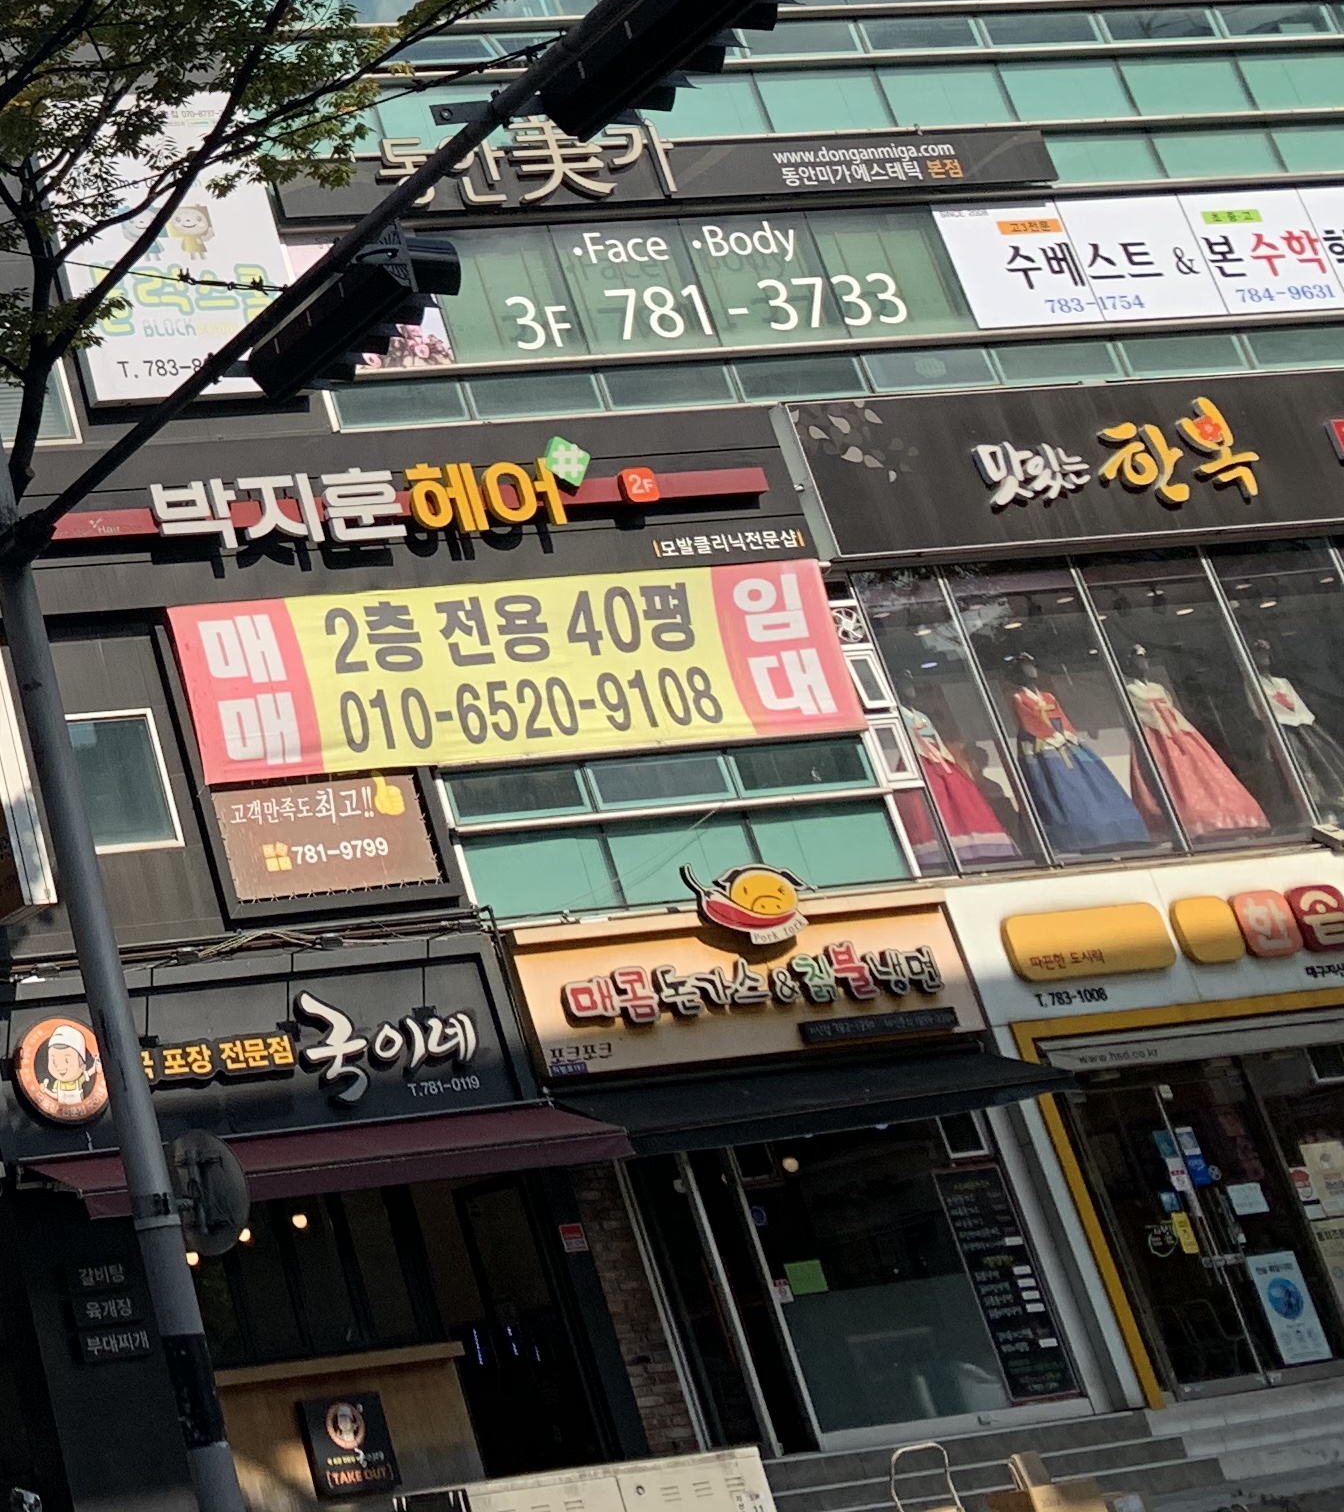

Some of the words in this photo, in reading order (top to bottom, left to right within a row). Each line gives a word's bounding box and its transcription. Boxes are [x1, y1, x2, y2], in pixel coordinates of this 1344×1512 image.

[772, 140, 955, 166] www.donganmiga.com
[781, 161, 924, 187] 동안미가에스테틱
[925, 157, 964, 181] 본점
[1005, 241, 1165, 291] 수베스트
[1173, 246, 1202, 277] &
[1044, 294, 1147, 316] 783-1754
[1235, 284, 1337, 305] 784-9631
[142, 318, 197, 338] BLOCK
[505, 294, 573, 351] 3F
[973, 441, 1091, 507] 맛있는
[1097, 396, 1261, 505] 한복
[628, 473, 655, 495] 2F
[660, 530, 799, 557] 모발클리닉전문샵
[324, 596, 425, 676] 2층
[439, 591, 551, 669] 전용
[566, 581, 695, 656] 40평
[732, 572, 839, 716] 임대
[339, 664, 724, 754] 010-6520-9108
[229, 797, 313, 826] 고객만족도
[315, 785, 375, 824] 최고!!
[291, 836, 389, 865] 781-9799
[1029, 952, 1067, 969] 따끈한
[1070, 948, 1106, 966] 도시락
[163, 1046, 212, 1075] 포장
[218, 1035, 296, 1072] 전문점
[296, 990, 477, 1102] 국이네
[549, 1041, 613, 1065] 포크포크
[1078, 1046, 1159, 1064] www.hsd.co.kr
[407, 1074, 481, 1098] T.781-0119
[78, 1263, 126, 1288] 갈비탕
[85, 1296, 133, 1321] 육개장
[85, 1330, 149, 1356] 부대찌개
